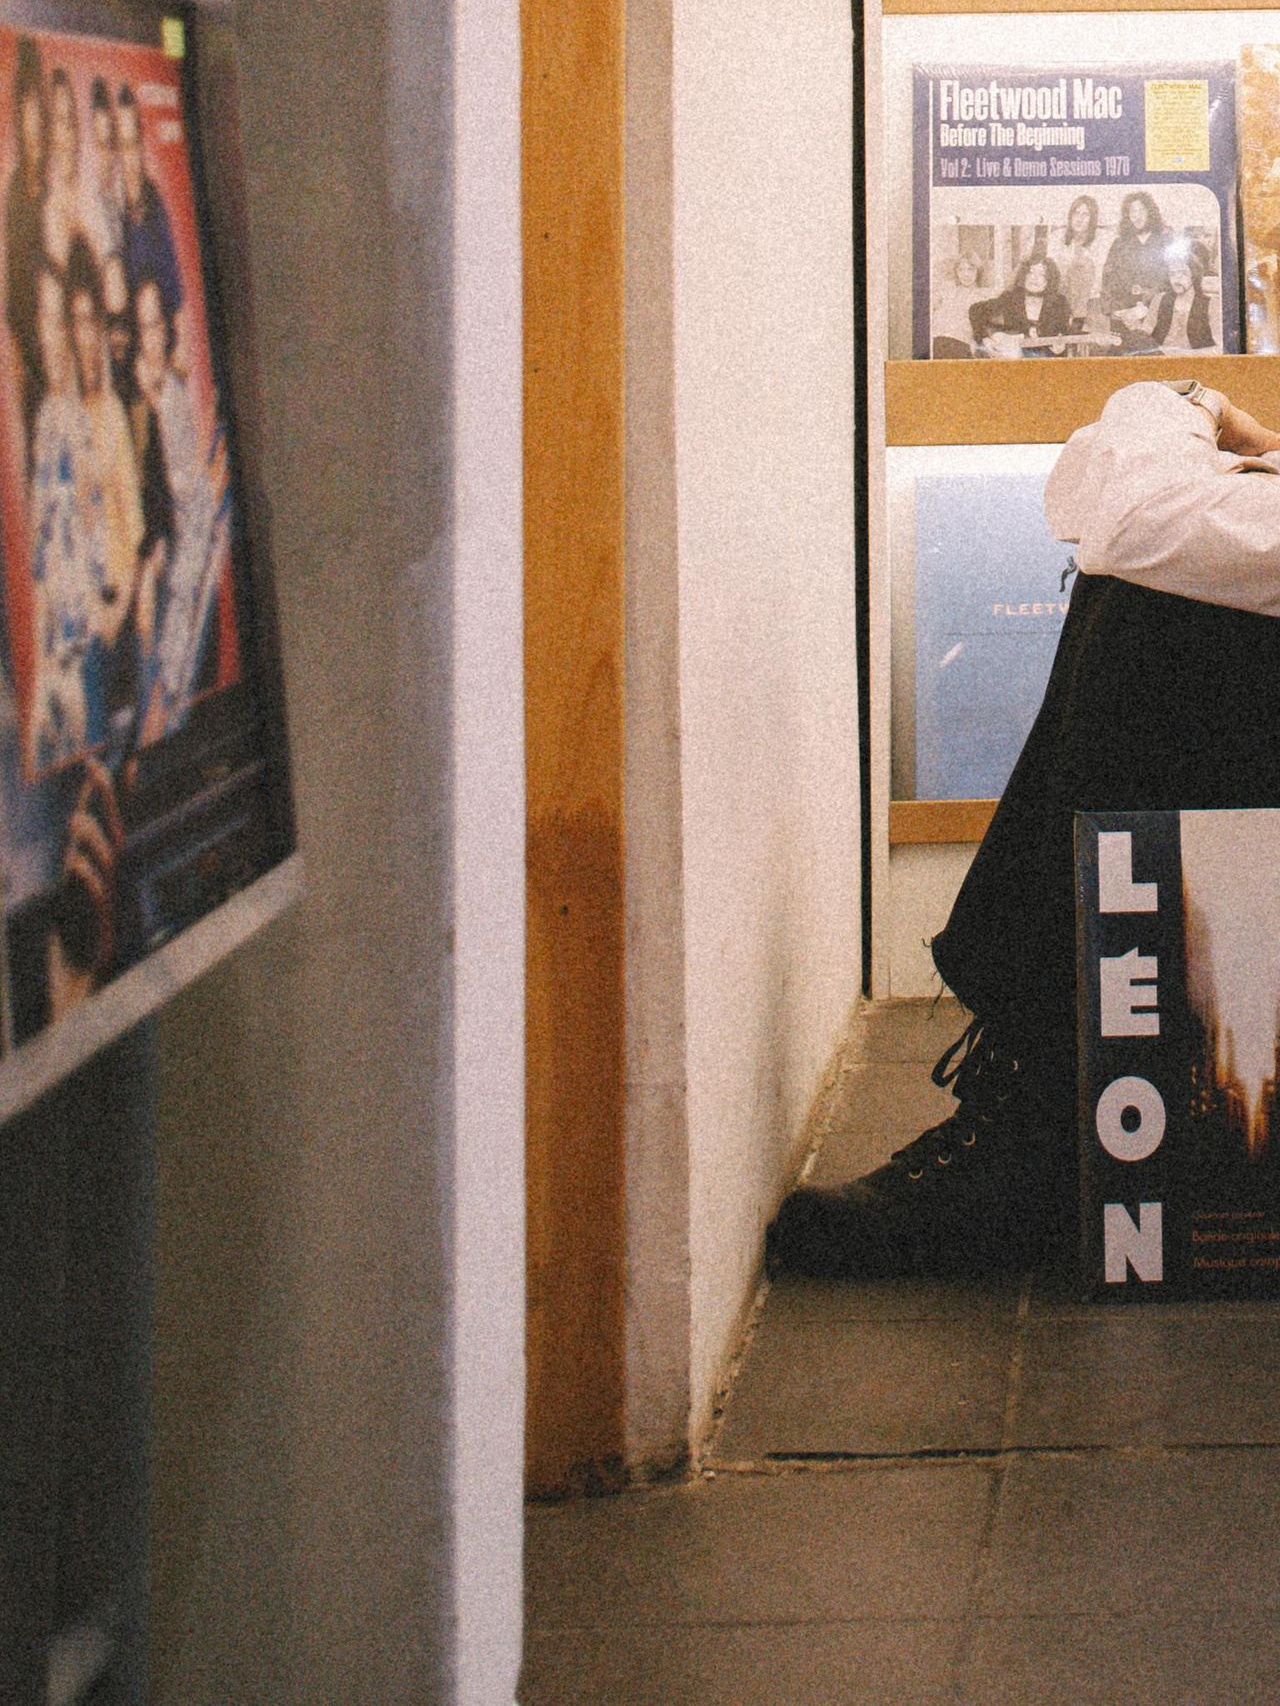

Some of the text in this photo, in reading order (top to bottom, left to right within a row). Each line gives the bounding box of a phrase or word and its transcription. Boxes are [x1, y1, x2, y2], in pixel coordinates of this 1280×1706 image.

[940, 78, 1122, 121] Fleetwood Mac
[940, 122, 1085, 151] Before The Beginning
[940, 158, 959, 178] Vol
[976, 157, 999, 178] Live
[1003, 157, 1011, 177] &
[1014, 156, 1047, 177] Demo
[1050, 156, 1101, 177] Sessions
[1104, 155, 1130, 176] 1970
[993, 603, 1070, 615] FLEETW
